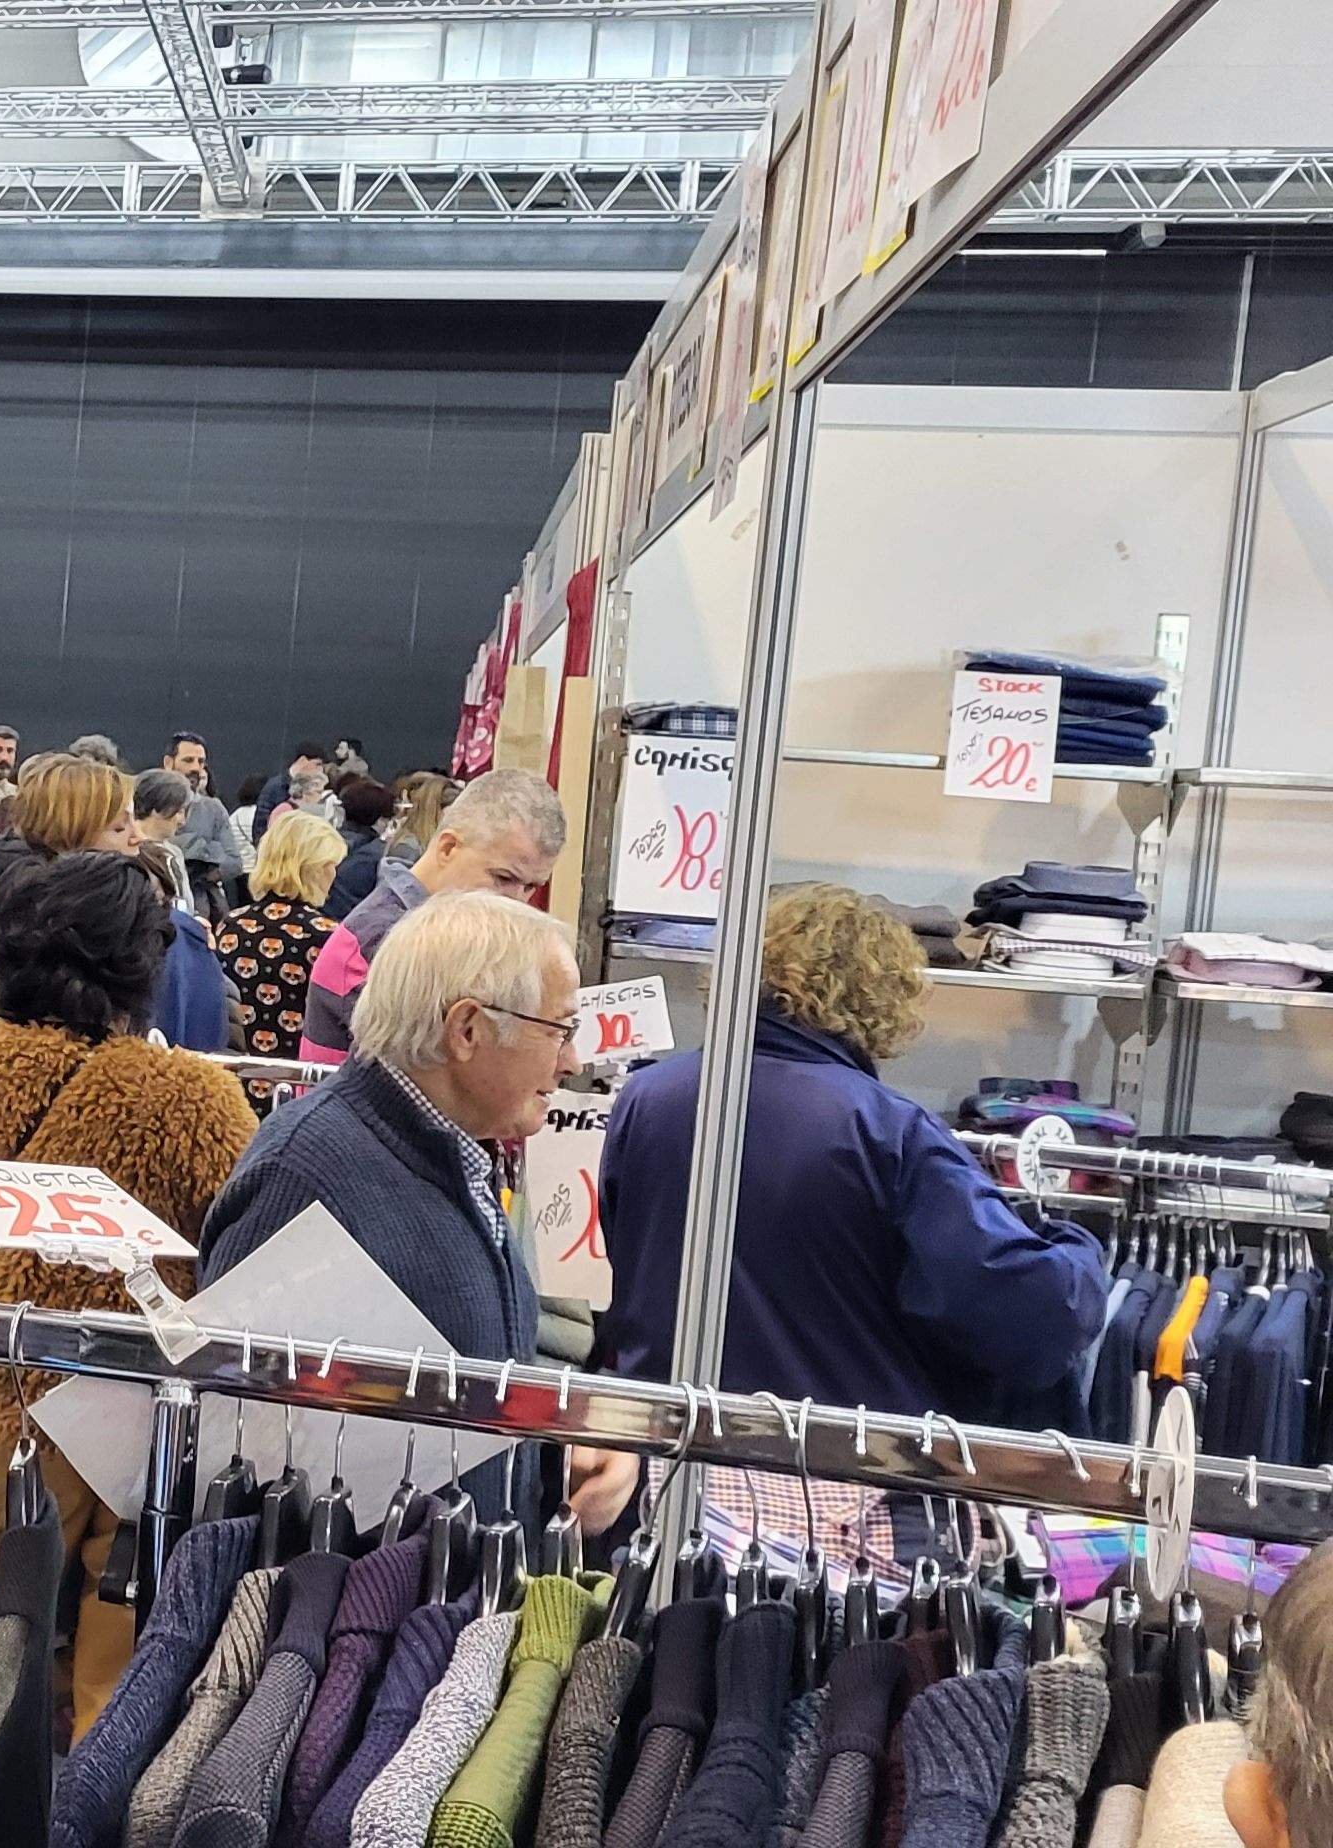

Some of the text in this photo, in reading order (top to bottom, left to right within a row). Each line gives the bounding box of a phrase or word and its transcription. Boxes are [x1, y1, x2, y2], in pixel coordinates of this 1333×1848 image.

[977, 677, 1045, 694] STOCK
[956, 698, 1048, 725] TEJANOS
[581, 984, 657, 1008] AMISETAS
